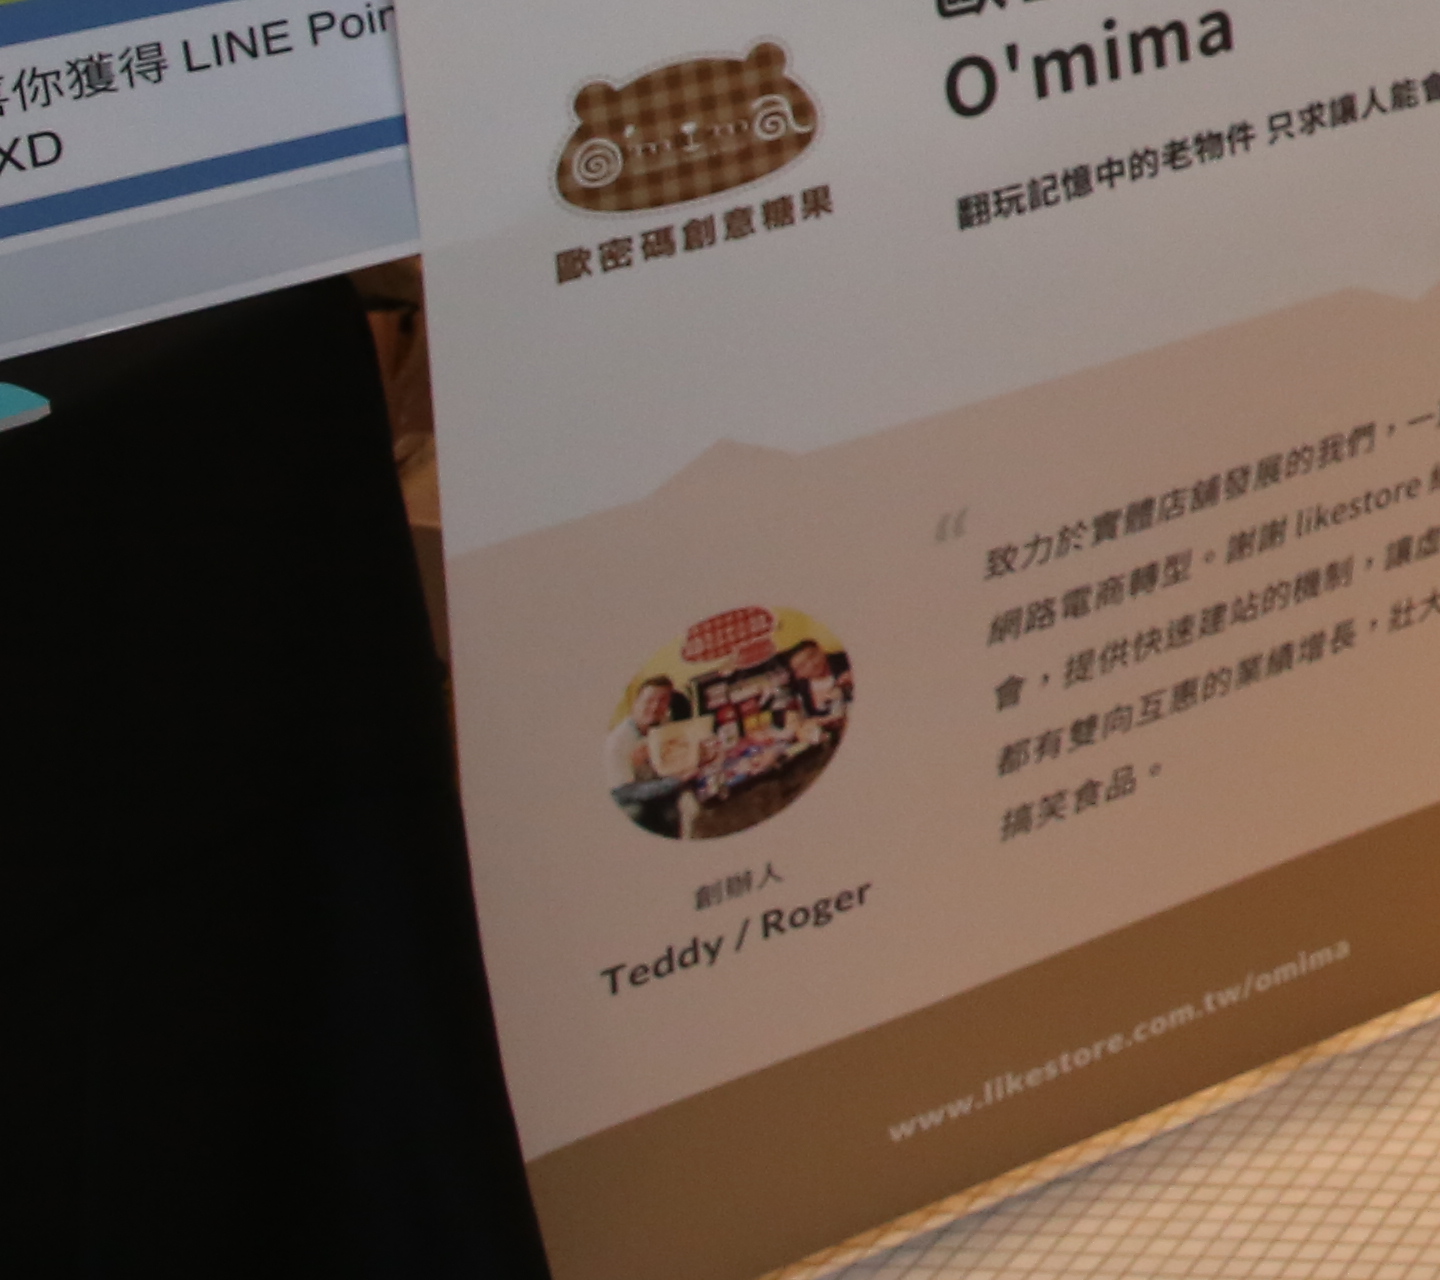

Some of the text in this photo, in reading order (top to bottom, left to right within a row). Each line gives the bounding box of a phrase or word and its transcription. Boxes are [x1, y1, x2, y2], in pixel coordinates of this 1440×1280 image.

[0, 41, 169, 117] 你獲得
[181, 19, 293, 73] LINE
[943, 4, 1235, 121] O'mima
[954, 120, 1258, 234] 翻玩記憶中的老物件
[554, 184, 836, 285] 歐密碼創意糖果
[1293, 478, 1422, 541] likestore
[599, 929, 725, 997] Teddy
[759, 880, 874, 940] Roger
[885, 939, 1353, 1145] www.likestore.com.tw/omima
